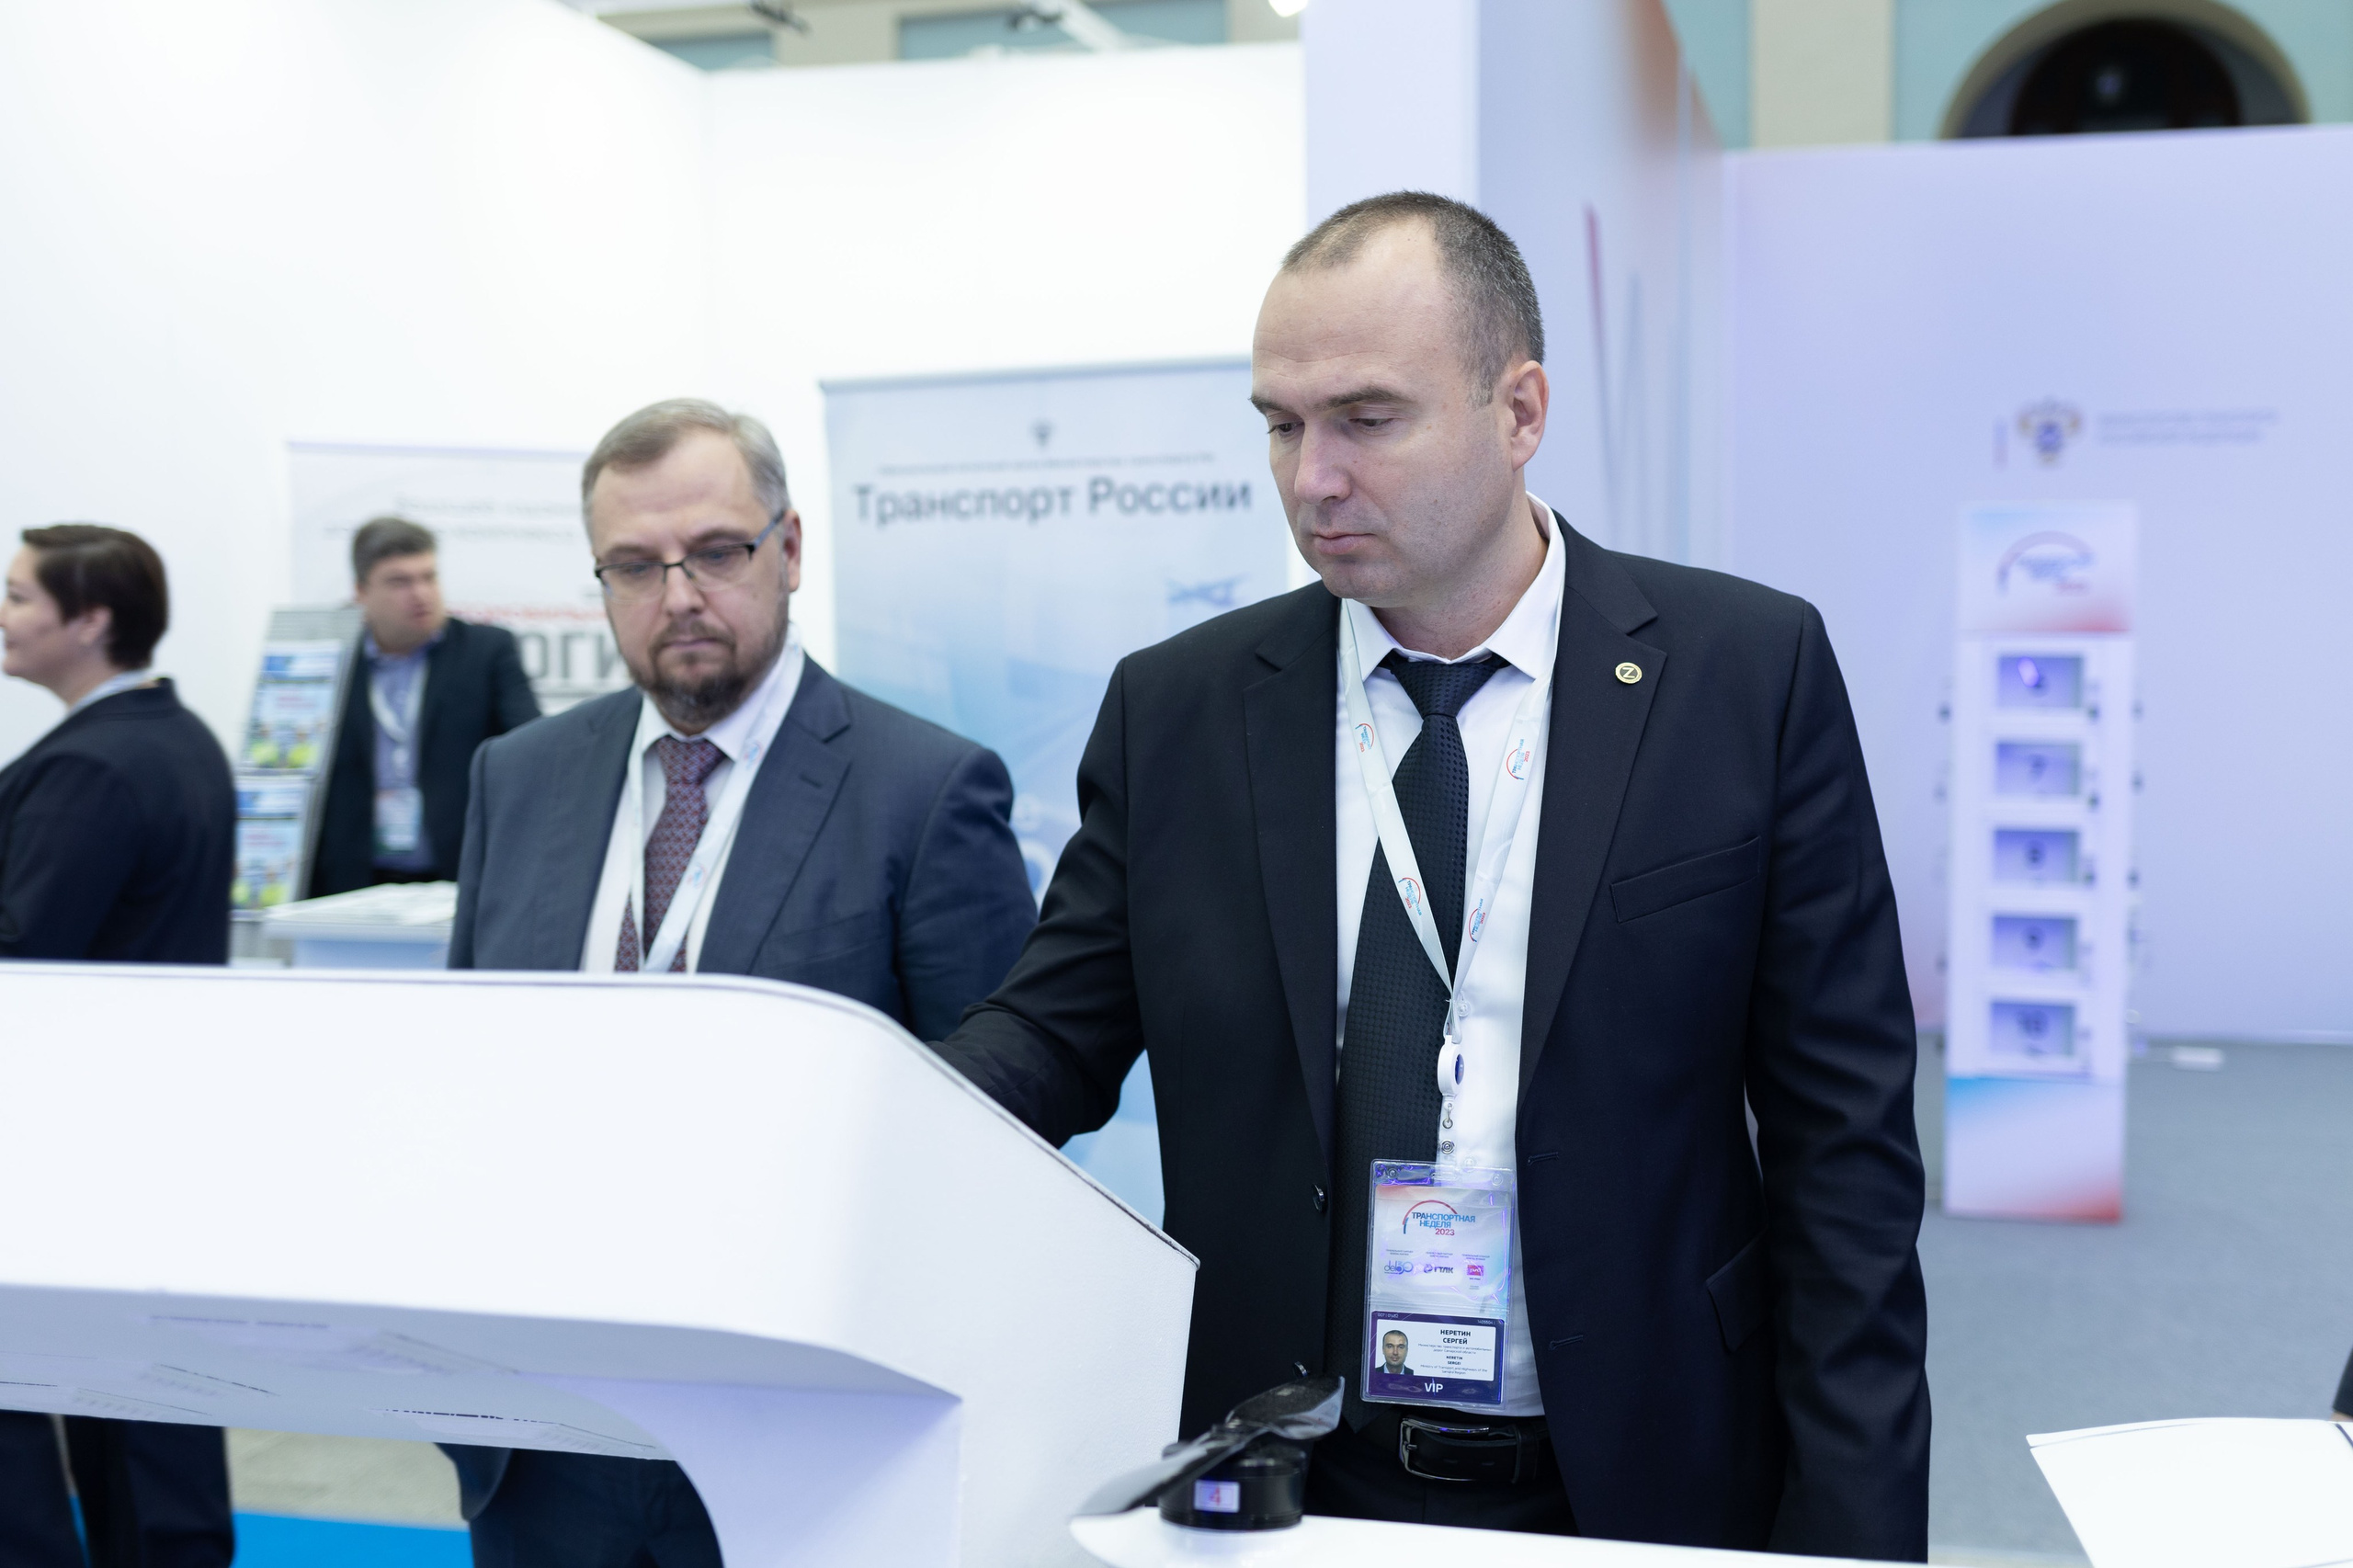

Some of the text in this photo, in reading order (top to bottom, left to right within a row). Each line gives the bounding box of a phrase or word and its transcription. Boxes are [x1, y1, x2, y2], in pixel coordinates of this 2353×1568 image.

[855, 477, 1251, 527] Транспорт России
[1621, 666, 1636, 678] Z
[1412, 1212, 1476, 1222] ТРАНСПОРТНАЯ
[1419, 1220, 1451, 1229] НЕДЕЛЯ
[1435, 1228, 1455, 1236] 2023
[1434, 1266, 1454, 1274] ГТЛК
[1424, 1382, 1444, 1393] VIP
